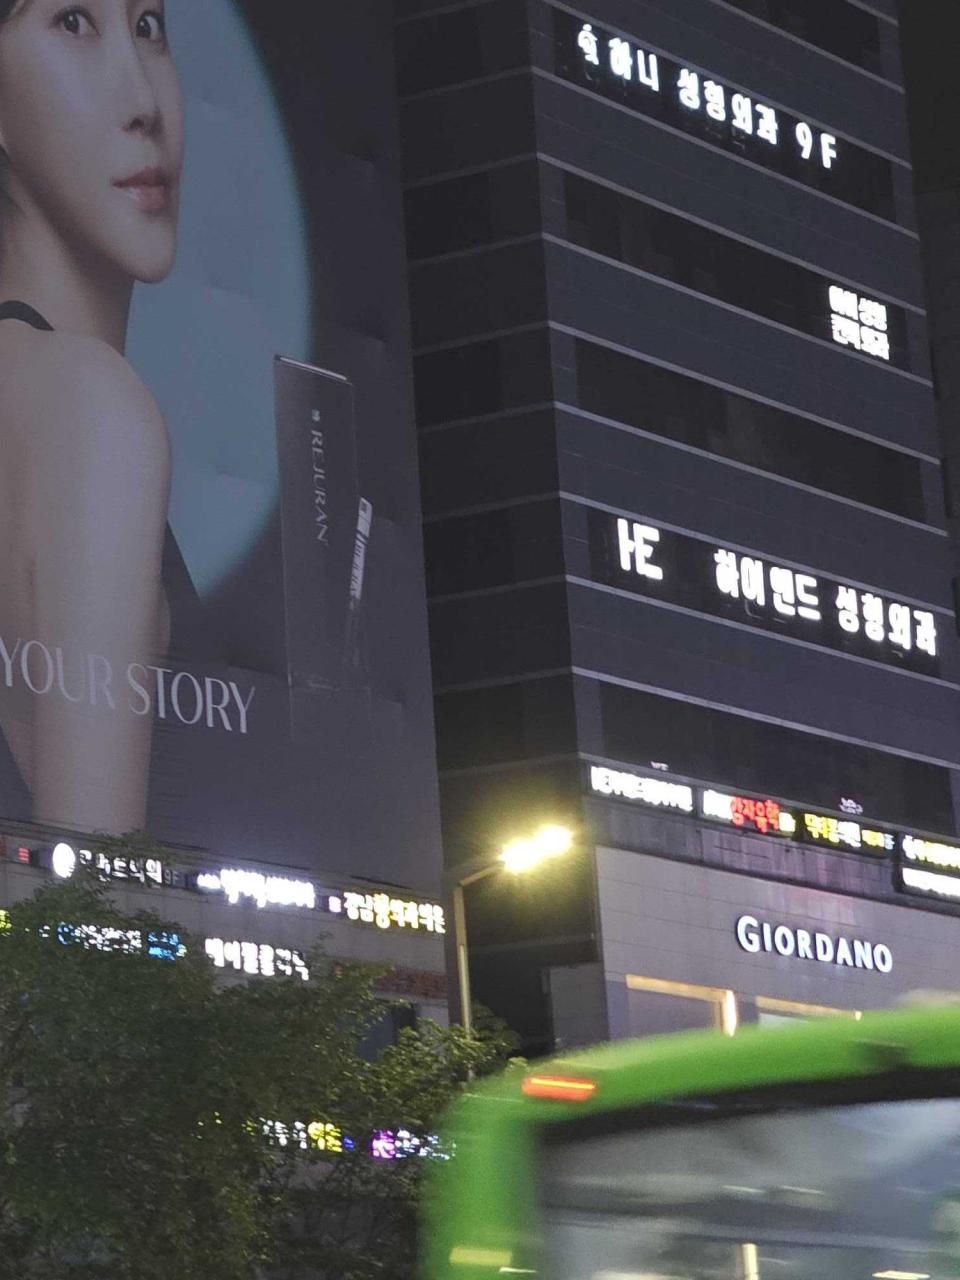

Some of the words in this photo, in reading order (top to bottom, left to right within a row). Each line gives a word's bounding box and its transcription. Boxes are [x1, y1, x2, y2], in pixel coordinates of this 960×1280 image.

[677, 68, 778, 145] 성형외과
[835, 585, 937, 657] 성형외과
[126, 663, 256, 734] STORY
[736, 914, 893, 974] GIORDANO
